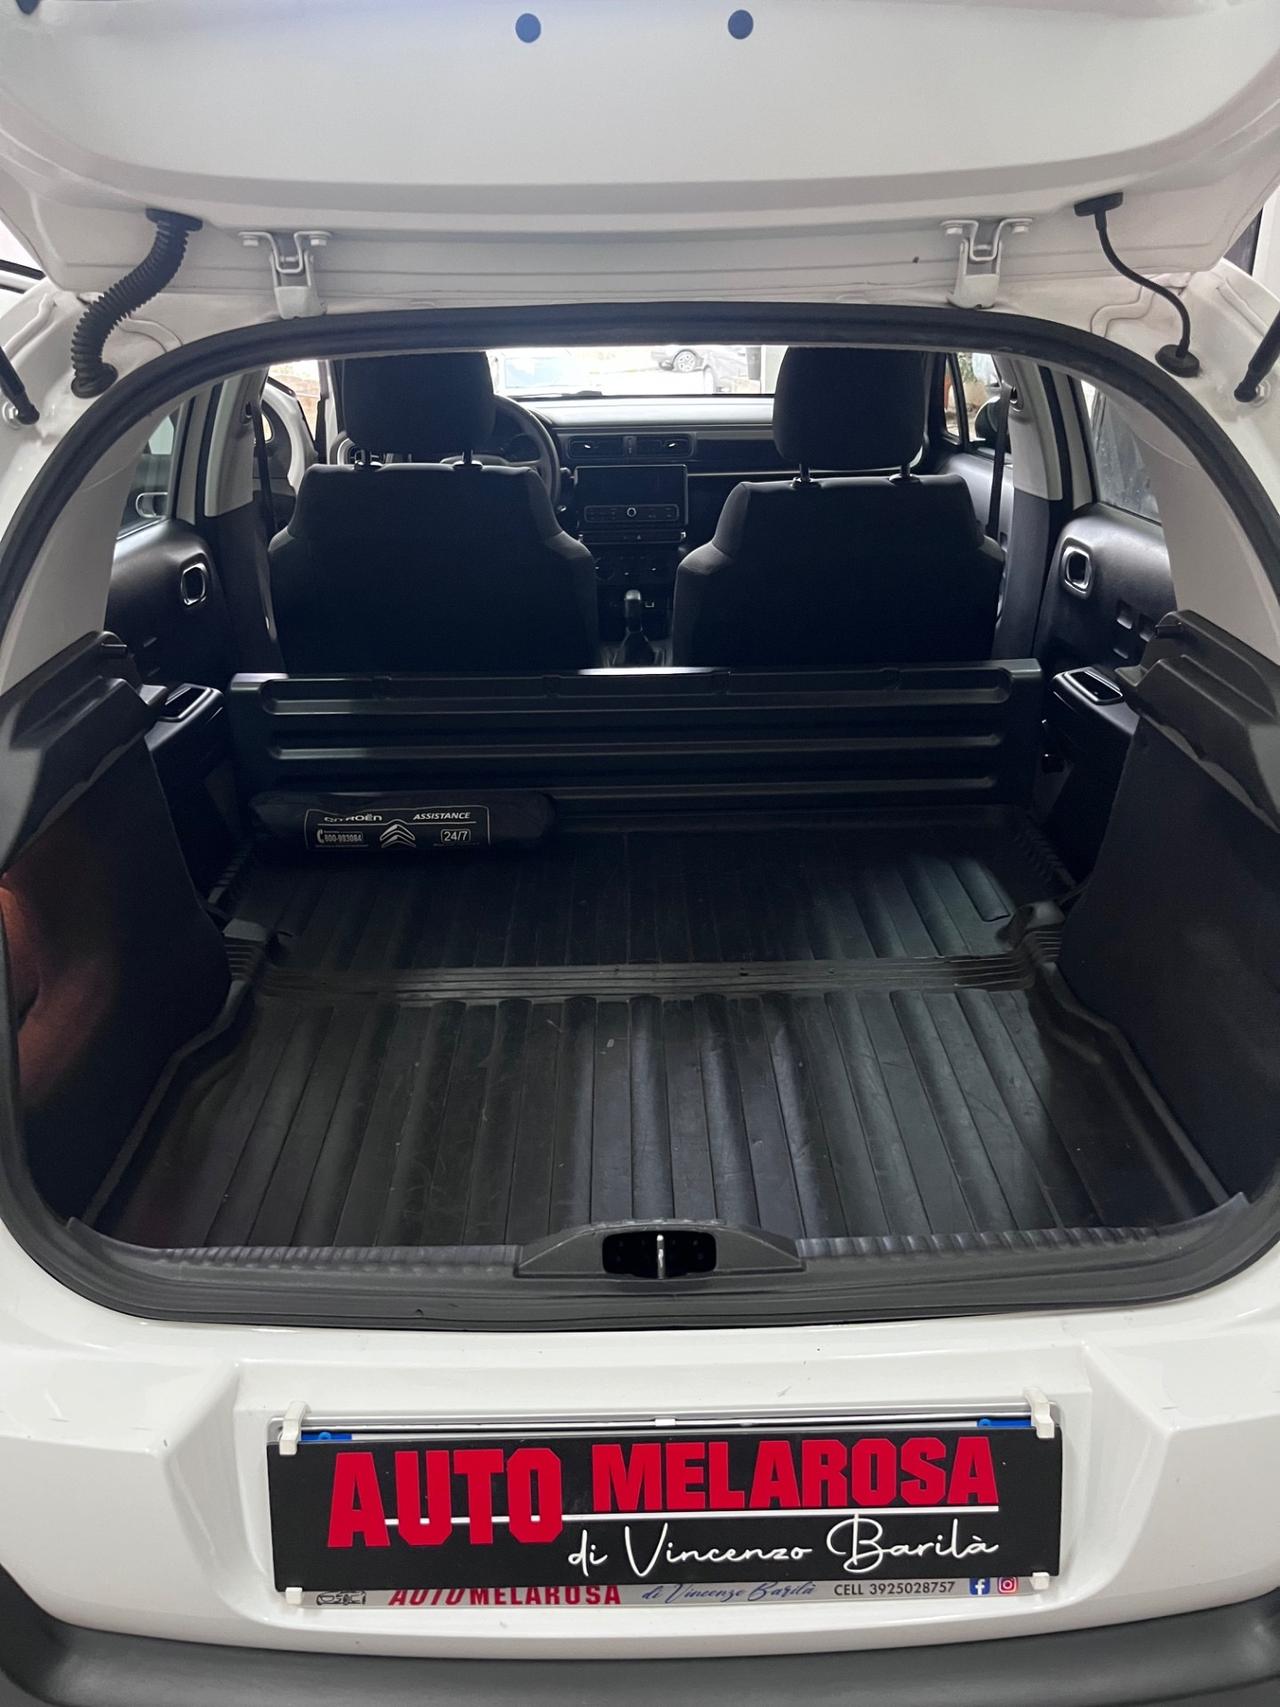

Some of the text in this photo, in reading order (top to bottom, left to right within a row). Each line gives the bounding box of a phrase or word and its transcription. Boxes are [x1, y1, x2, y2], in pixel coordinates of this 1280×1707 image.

[412, 811, 472, 821] ASSISTANCE
[443, 830, 468, 842] 24/7
[326, 1435, 1000, 1548] AUTO MELAROSA
[567, 1513, 1000, 1577] di Vincenzo Barilà
[641, 1585, 663, 1599] di
[834, 1584, 863, 1596] CELL
[869, 1581, 956, 1595] 3925028757
